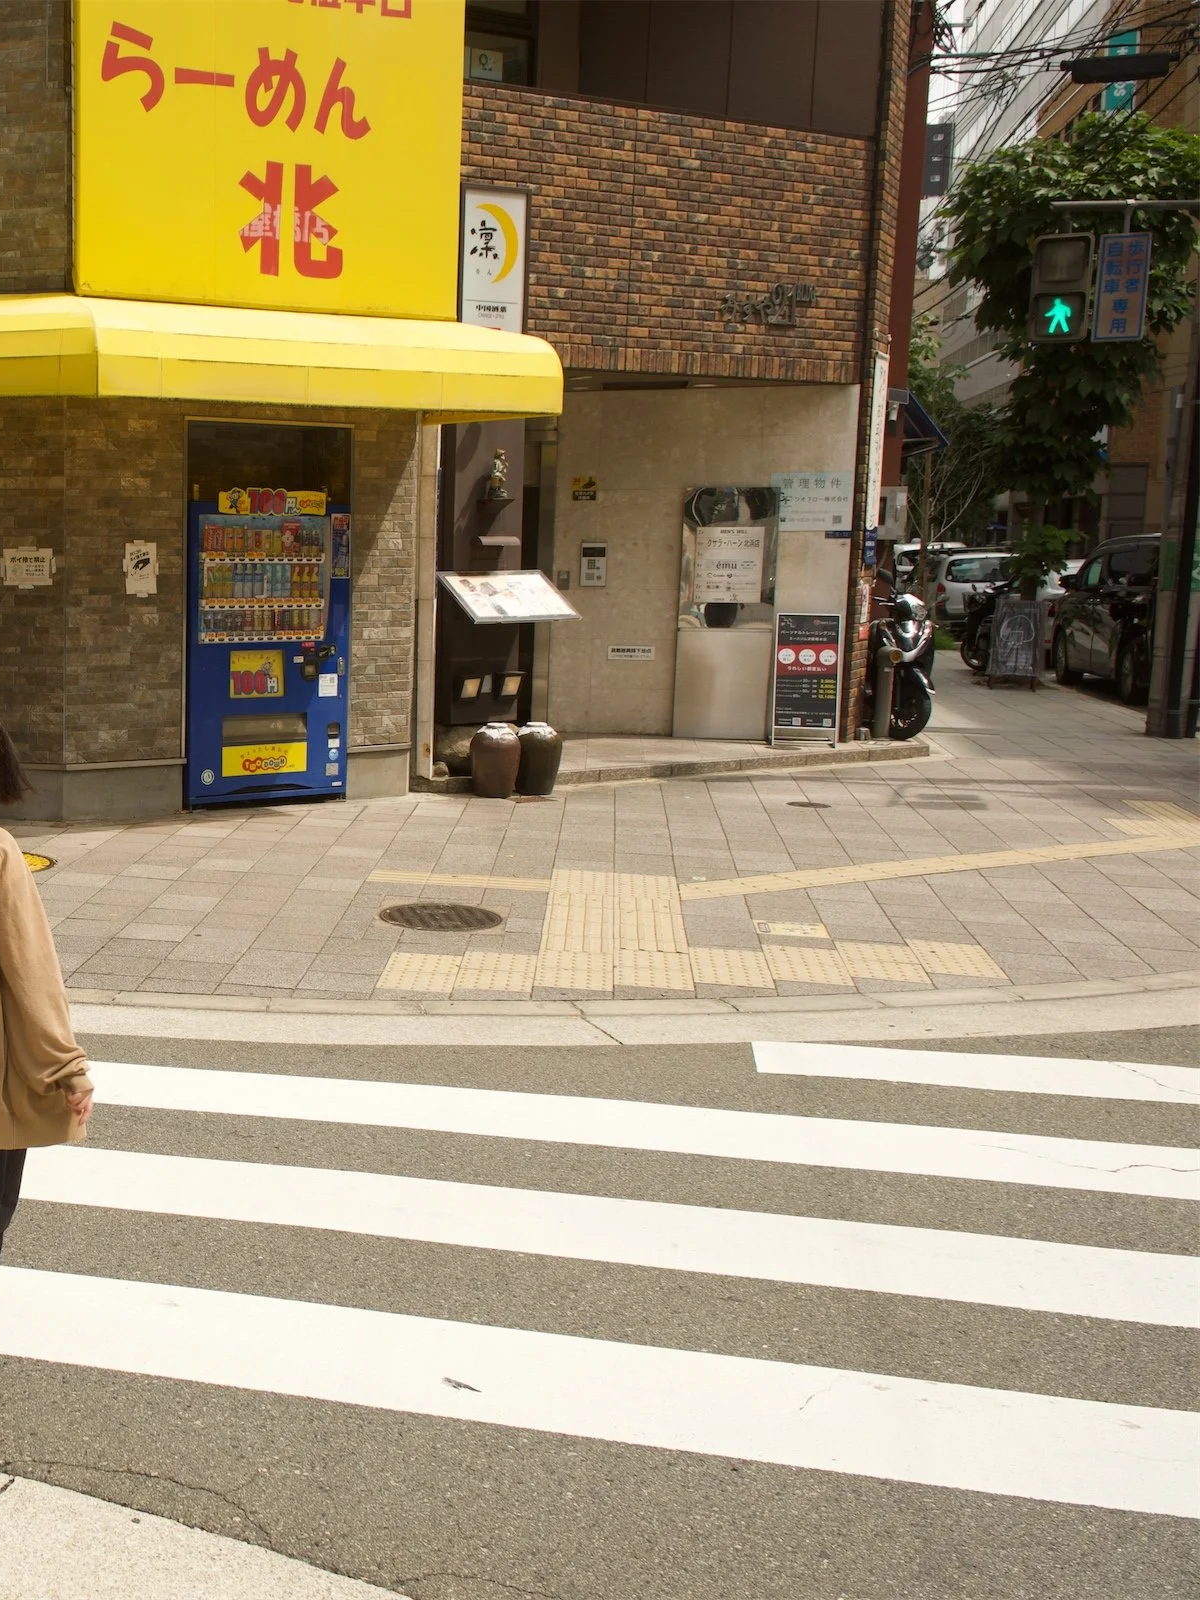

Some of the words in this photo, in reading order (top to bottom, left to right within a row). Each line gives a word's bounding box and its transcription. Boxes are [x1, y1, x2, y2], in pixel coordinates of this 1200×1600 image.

[101, 21, 371, 140] らーめん
[238, 160, 343, 279] 北
[1103, 241, 1124, 294] 自転車
[1125, 240, 1145, 293] 歩行者
[1108, 298, 1129, 334] 専用
[782, 477, 842, 489] 管理物件
[10, 556, 46, 564] ポイ捨て禁止
[716, 560, 738, 570] ému
[230, 670, 279, 695] 100円
[262, 756, 286, 769] DOWN
